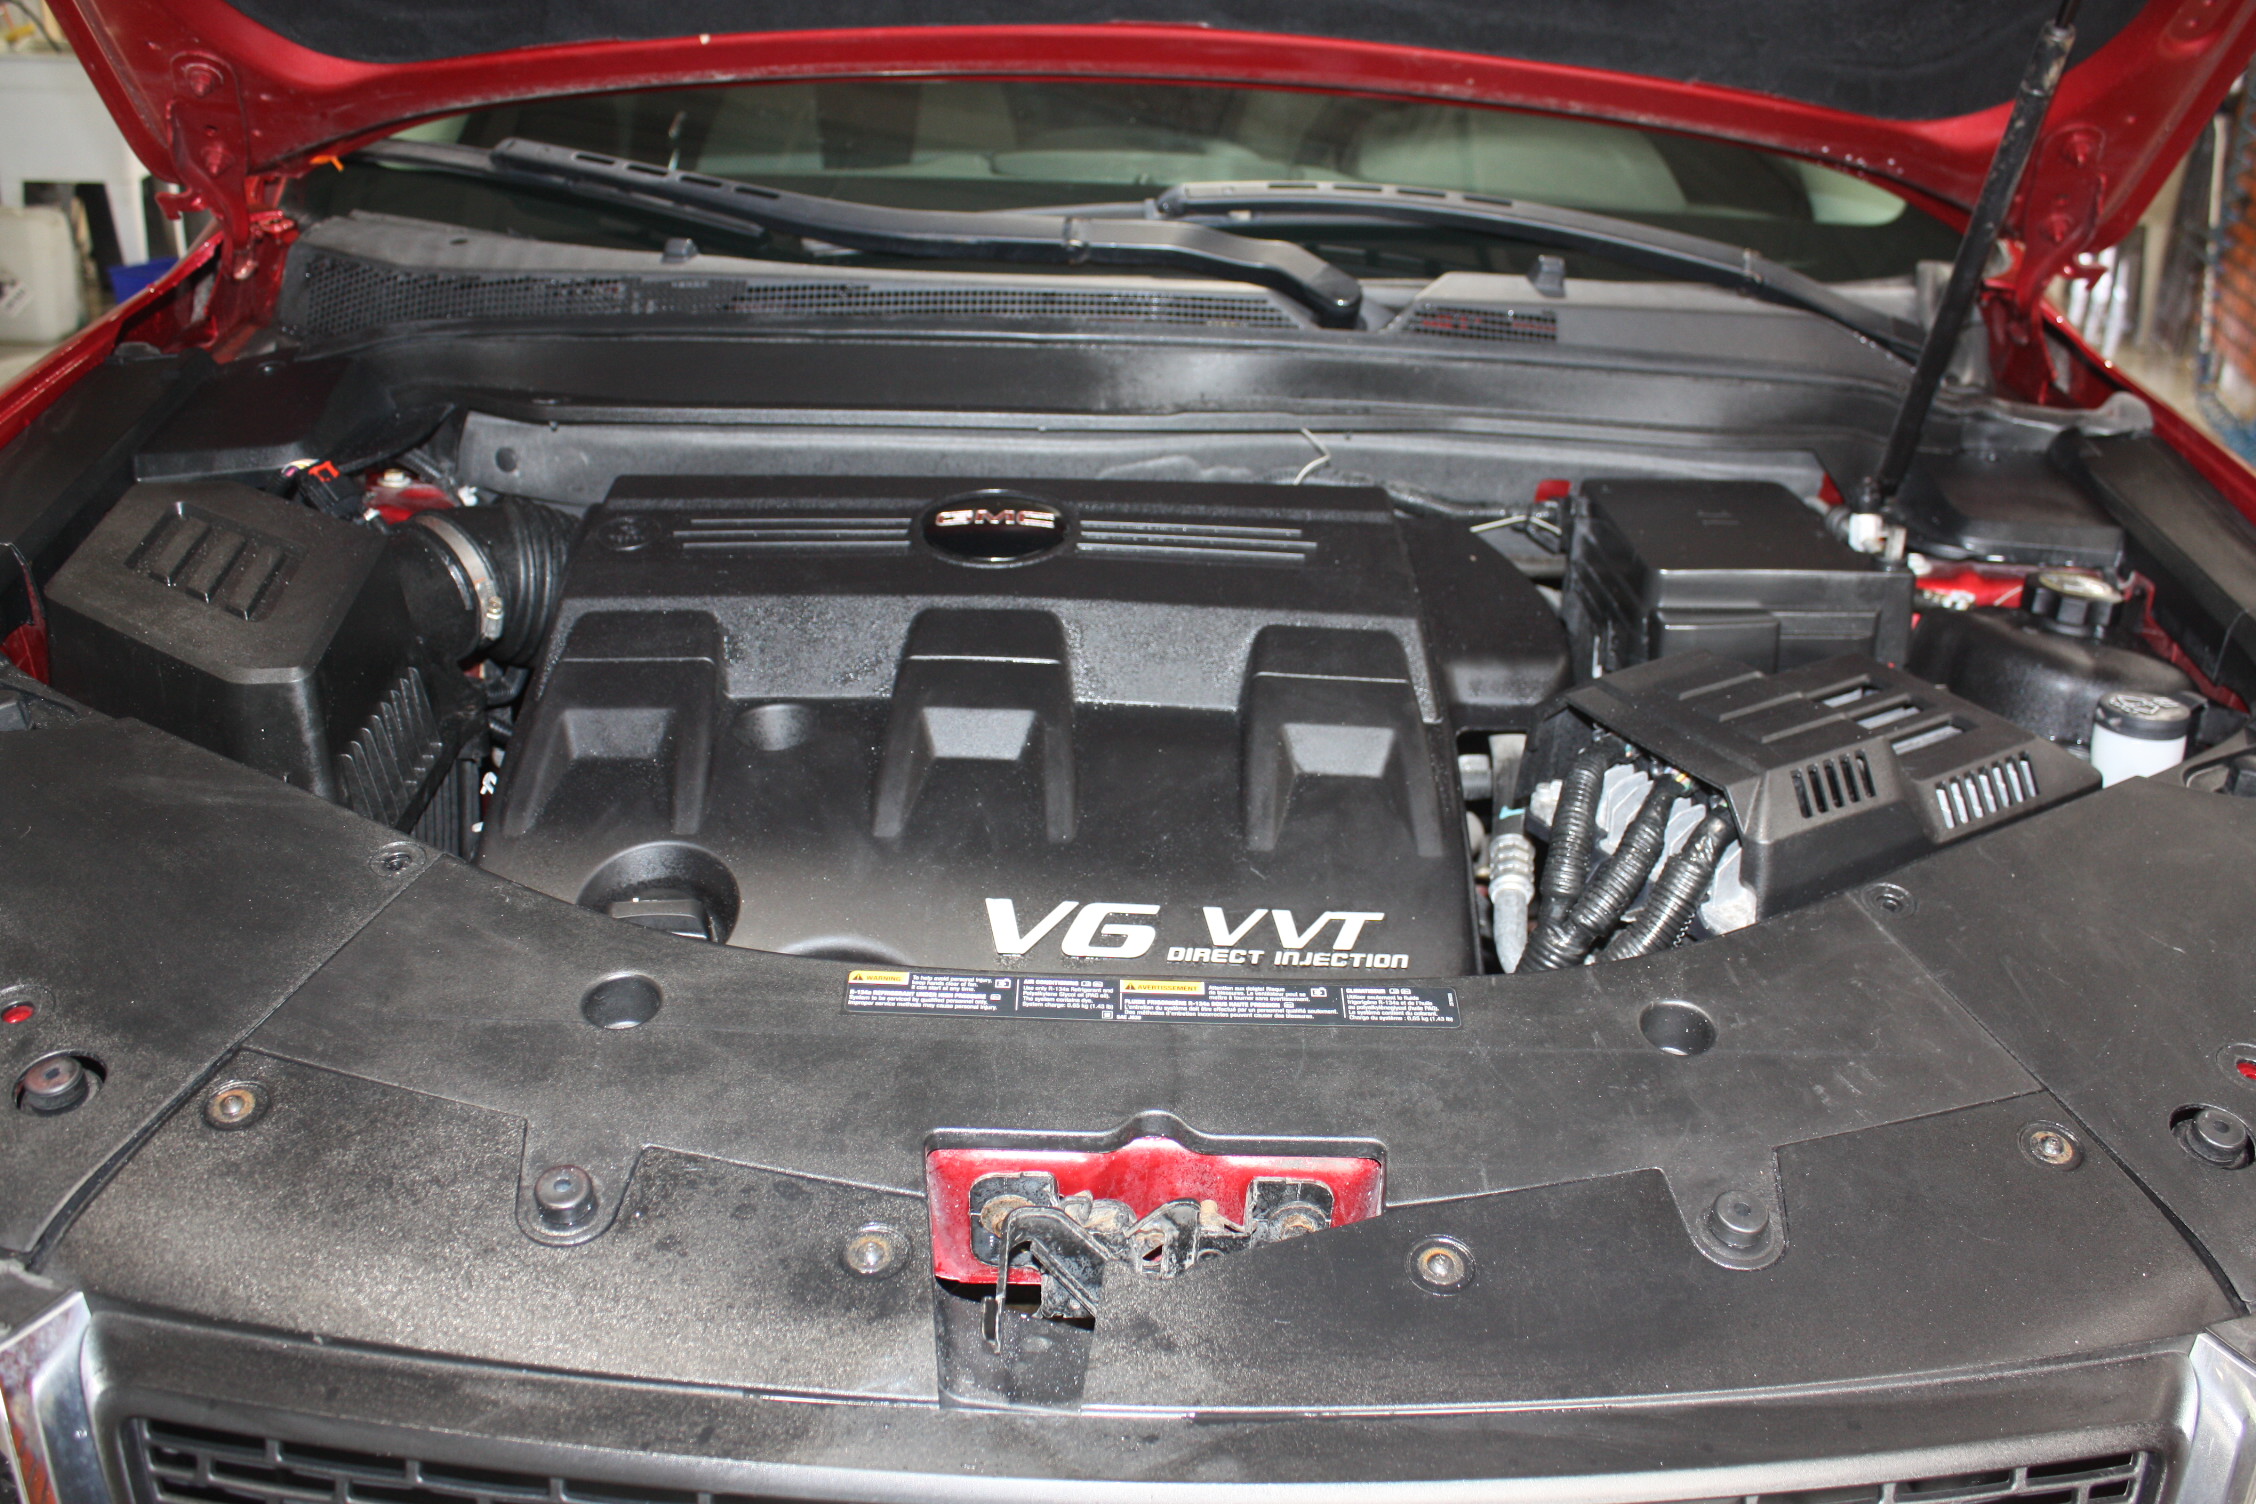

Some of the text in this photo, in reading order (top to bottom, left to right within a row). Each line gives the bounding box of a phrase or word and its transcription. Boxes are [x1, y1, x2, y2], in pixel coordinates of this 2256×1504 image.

[935, 509, 1055, 528] GMC
[985, 898, 1385, 959] V6 VVT
[1166, 946, 1409, 970] DIRECT INJECTION
